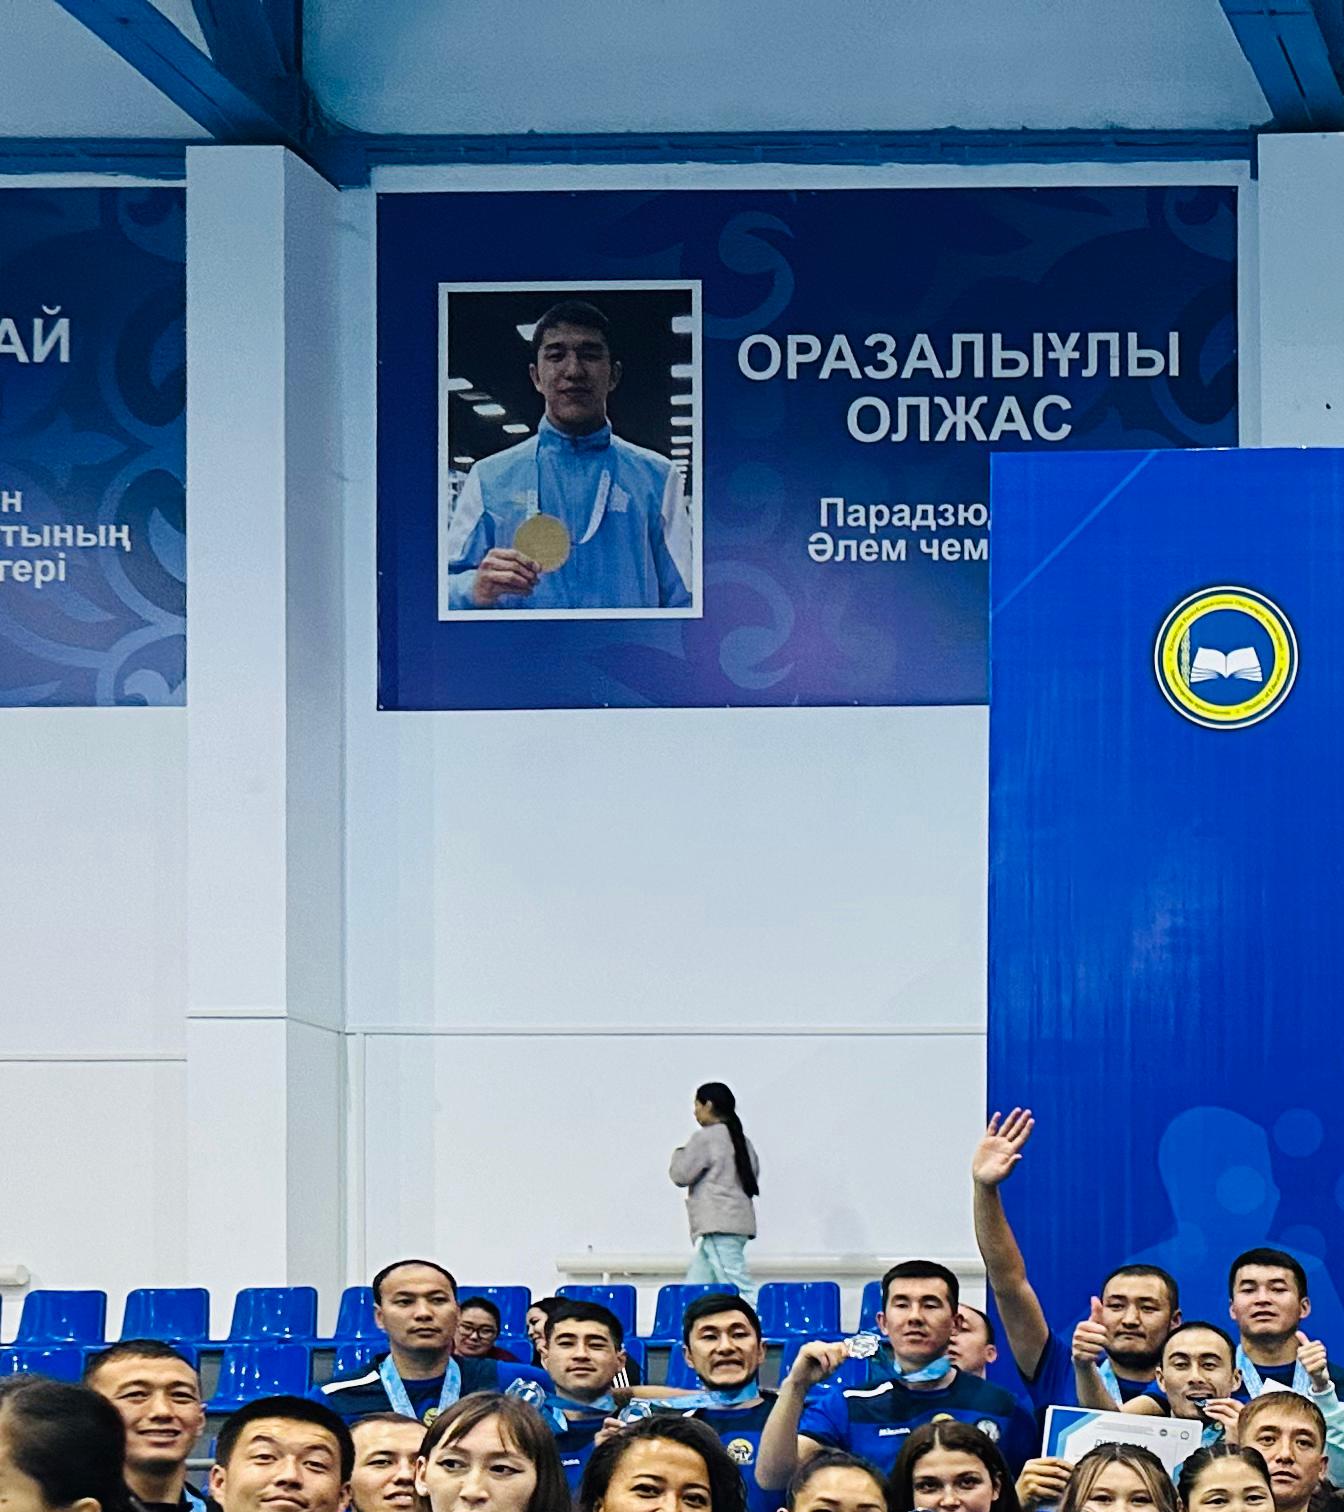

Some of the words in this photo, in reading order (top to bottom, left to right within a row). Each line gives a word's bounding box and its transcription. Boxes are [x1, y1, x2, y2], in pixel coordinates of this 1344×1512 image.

[737, 330, 1180, 381] ОРАЗАЛЫҰЛЫ
[846, 395, 1073, 444] ОЛЖАС
[819, 497, 991, 534] Парадзю
[807, 531, 906, 562] Әлем
[919, 535, 989, 562] чем
